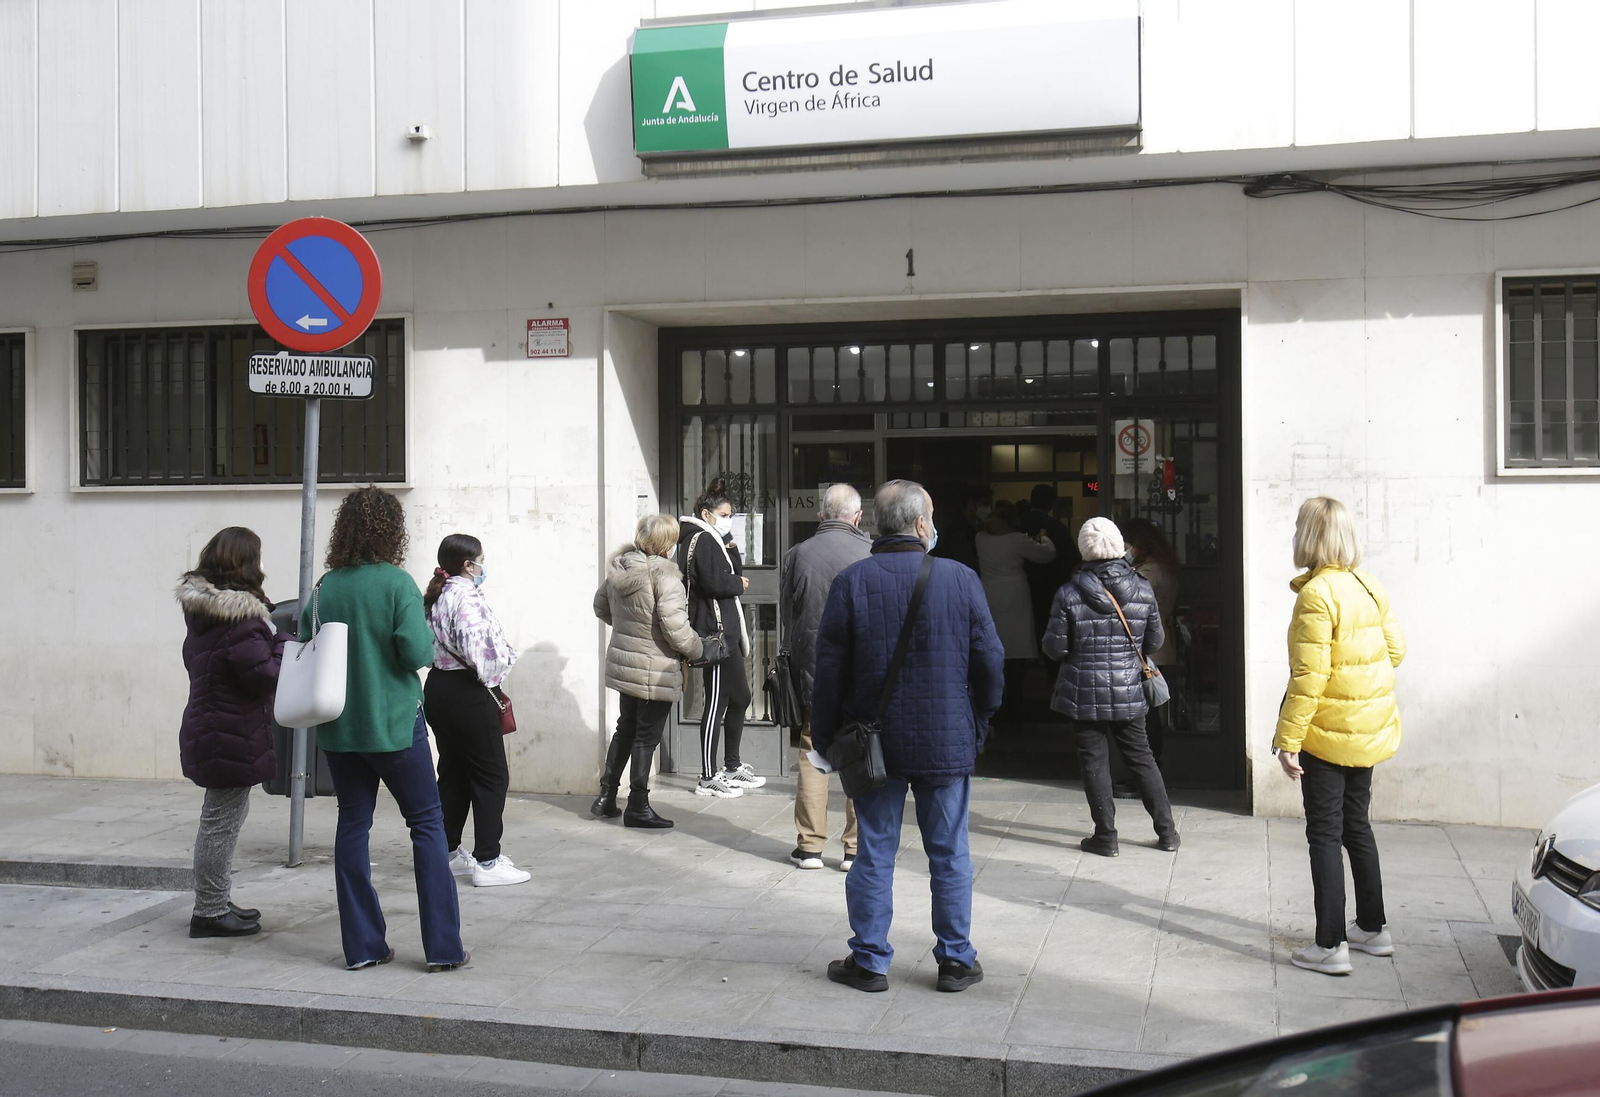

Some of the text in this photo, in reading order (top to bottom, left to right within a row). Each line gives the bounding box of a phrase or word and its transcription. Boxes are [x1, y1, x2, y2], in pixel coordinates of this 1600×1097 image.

[742, 58, 934, 92] Centro de Salud
[744, 90, 881, 118] Virgen de África
[641, 112, 719, 126] Junta de Andalucía
[905, 248, 916, 276] 1
[250, 357, 372, 379] RESERVADO AMBULANCIA
[265, 380, 354, 396] de 8.00 a 20.00 H.
